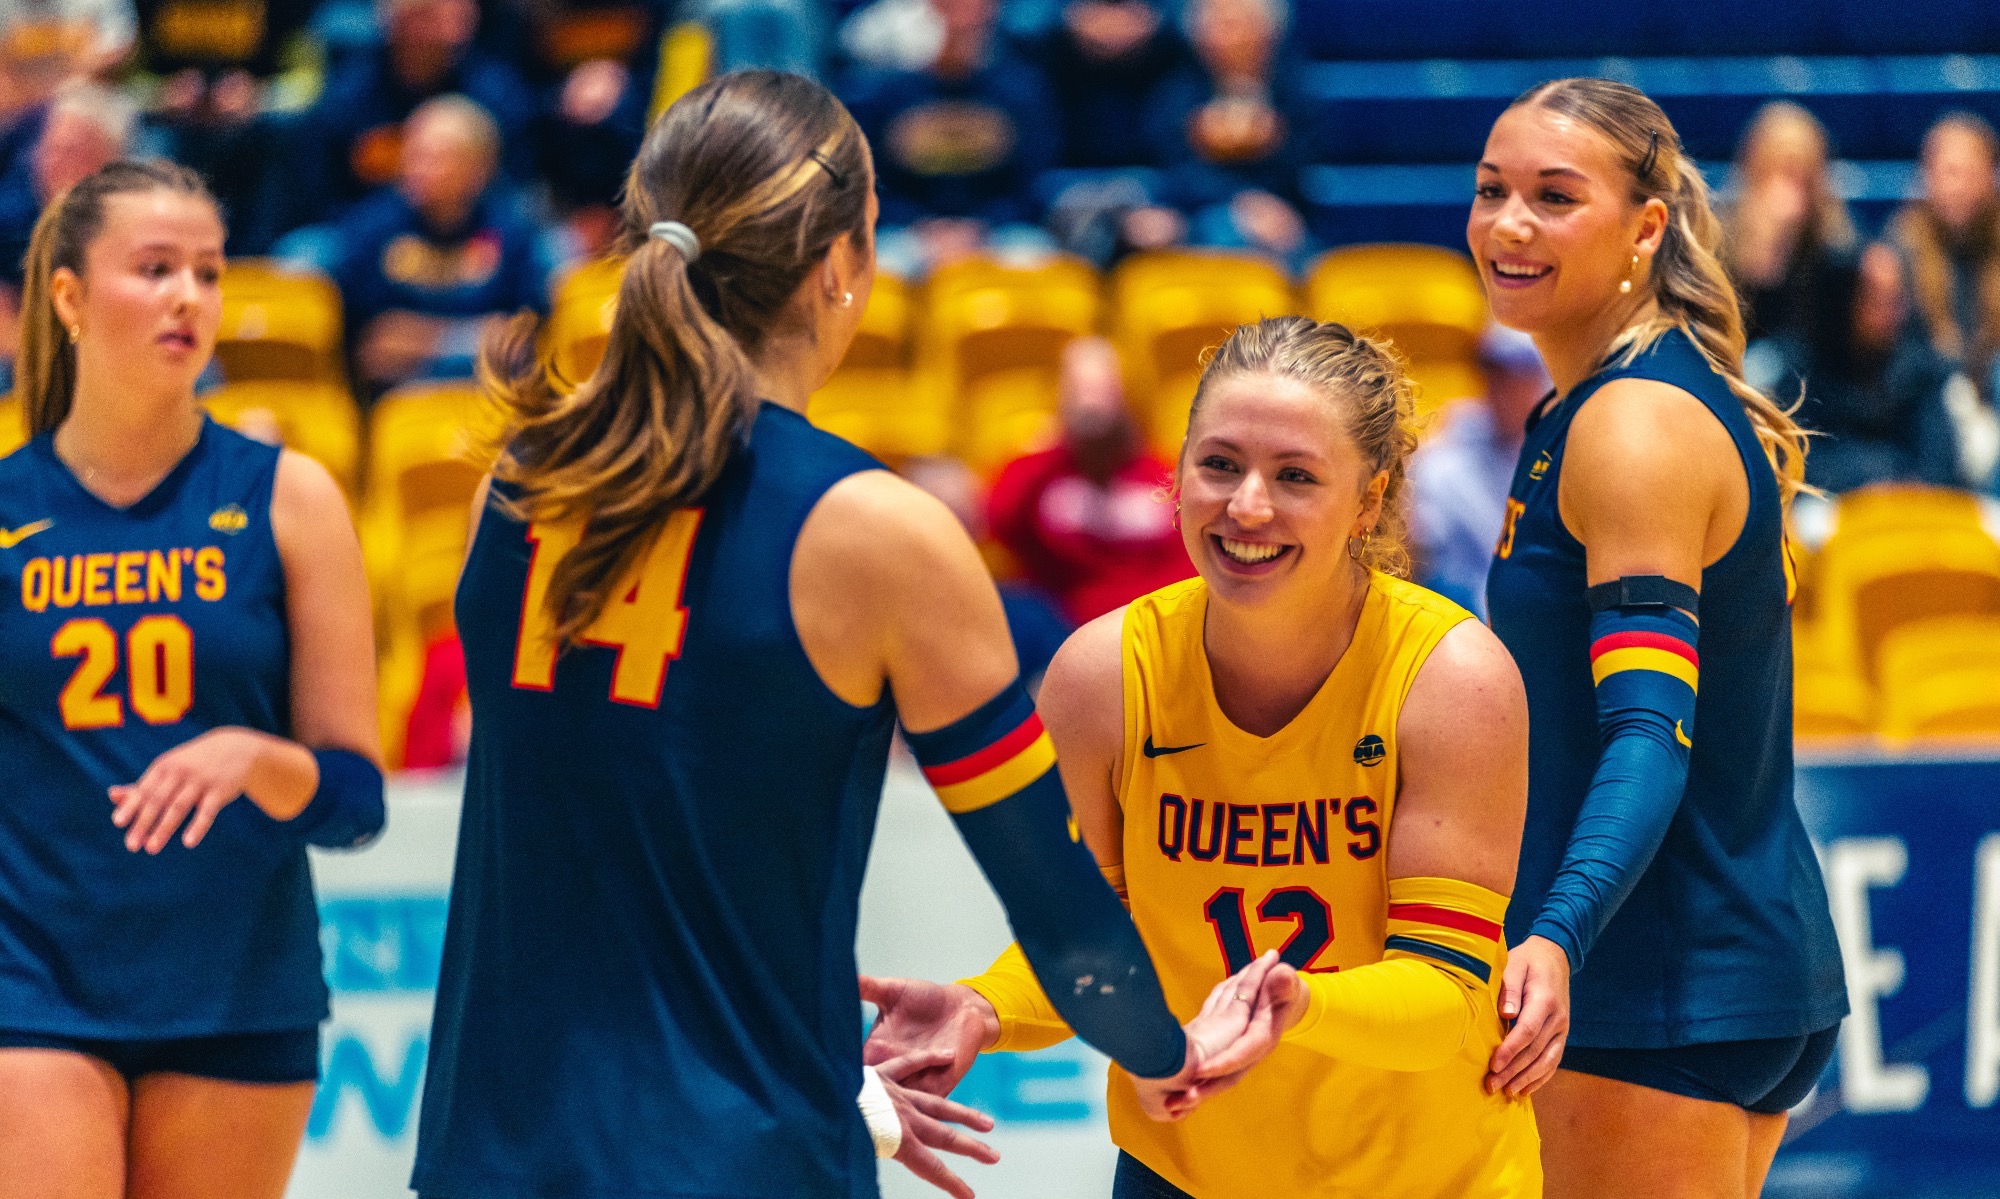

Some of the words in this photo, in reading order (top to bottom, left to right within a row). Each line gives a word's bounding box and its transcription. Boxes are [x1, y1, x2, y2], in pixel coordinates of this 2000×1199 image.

[21, 545, 227, 613] QUEEN'S
[511, 506, 706, 710] 14
[50, 613, 195, 731] 20
[1157, 792, 1382, 868] QUEEN'S
[1203, 885, 1340, 981] 12
